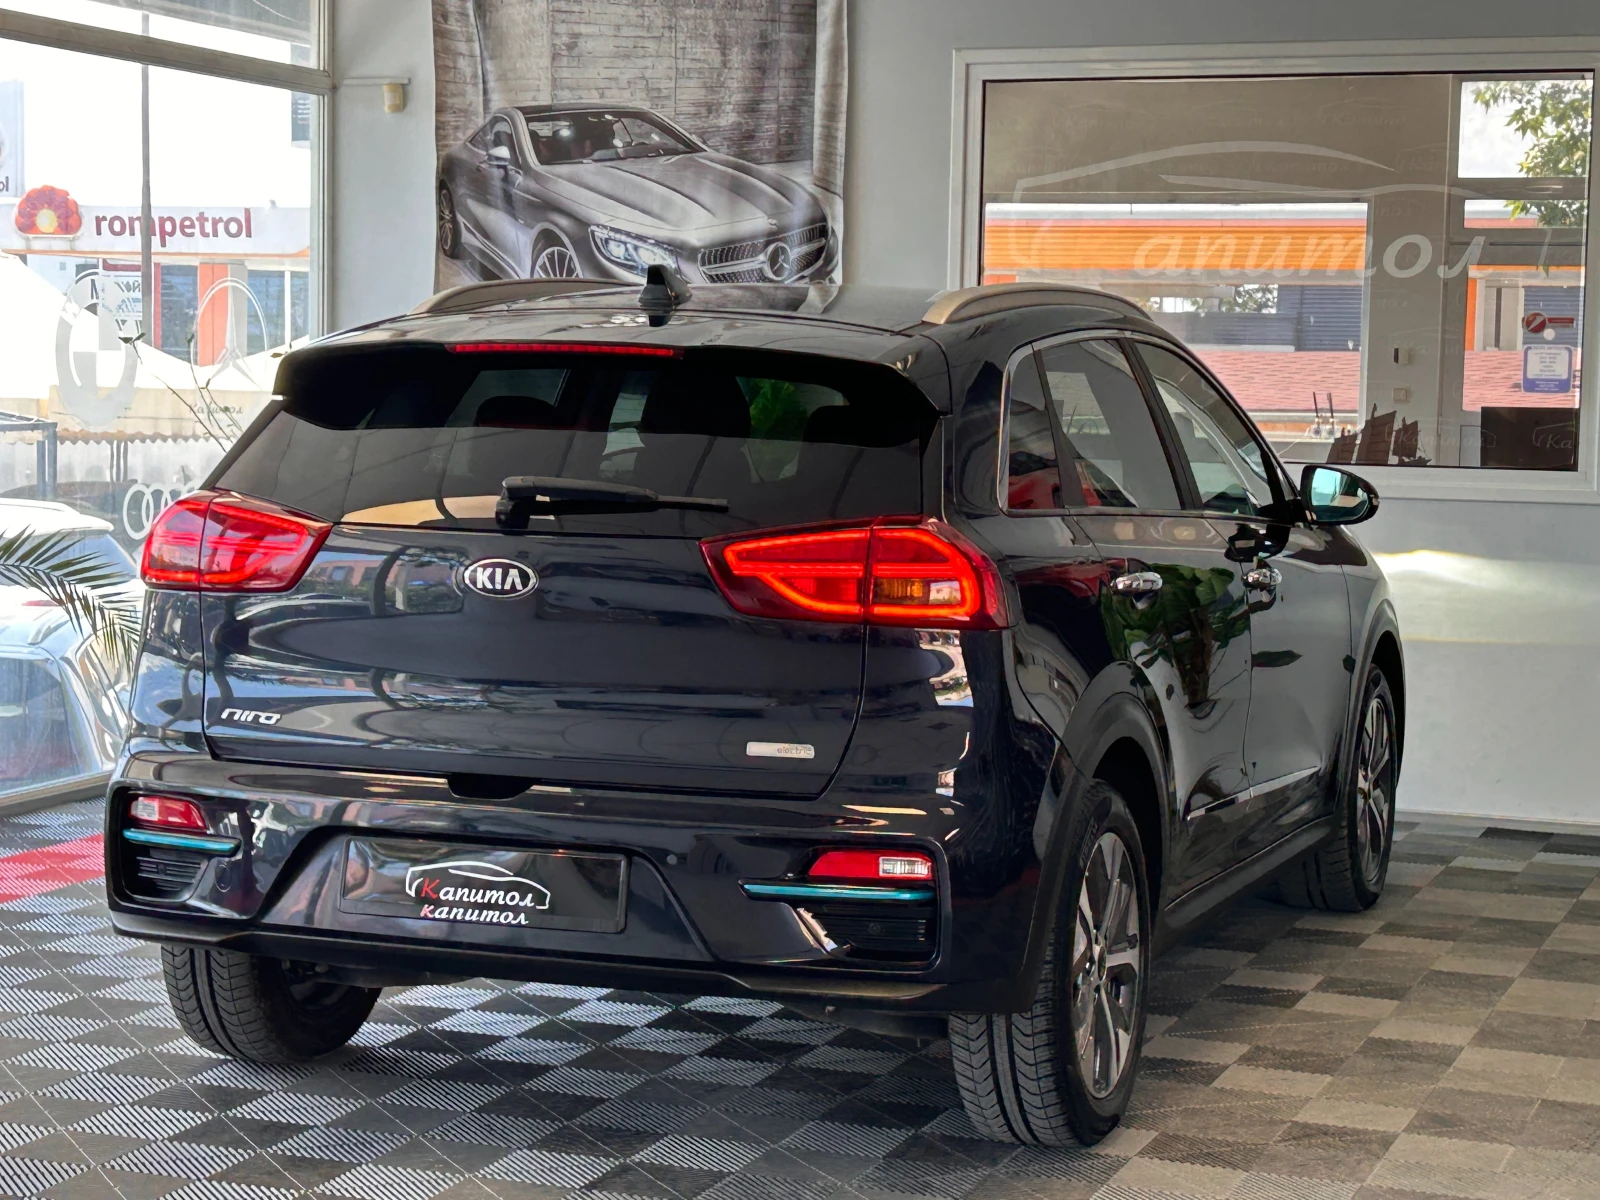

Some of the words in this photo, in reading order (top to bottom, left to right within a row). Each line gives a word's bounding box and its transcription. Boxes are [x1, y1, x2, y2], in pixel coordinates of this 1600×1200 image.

[95, 207, 252, 248] rompetrol
[476, 567, 523, 591] KIA
[220, 708, 281, 725] niro
